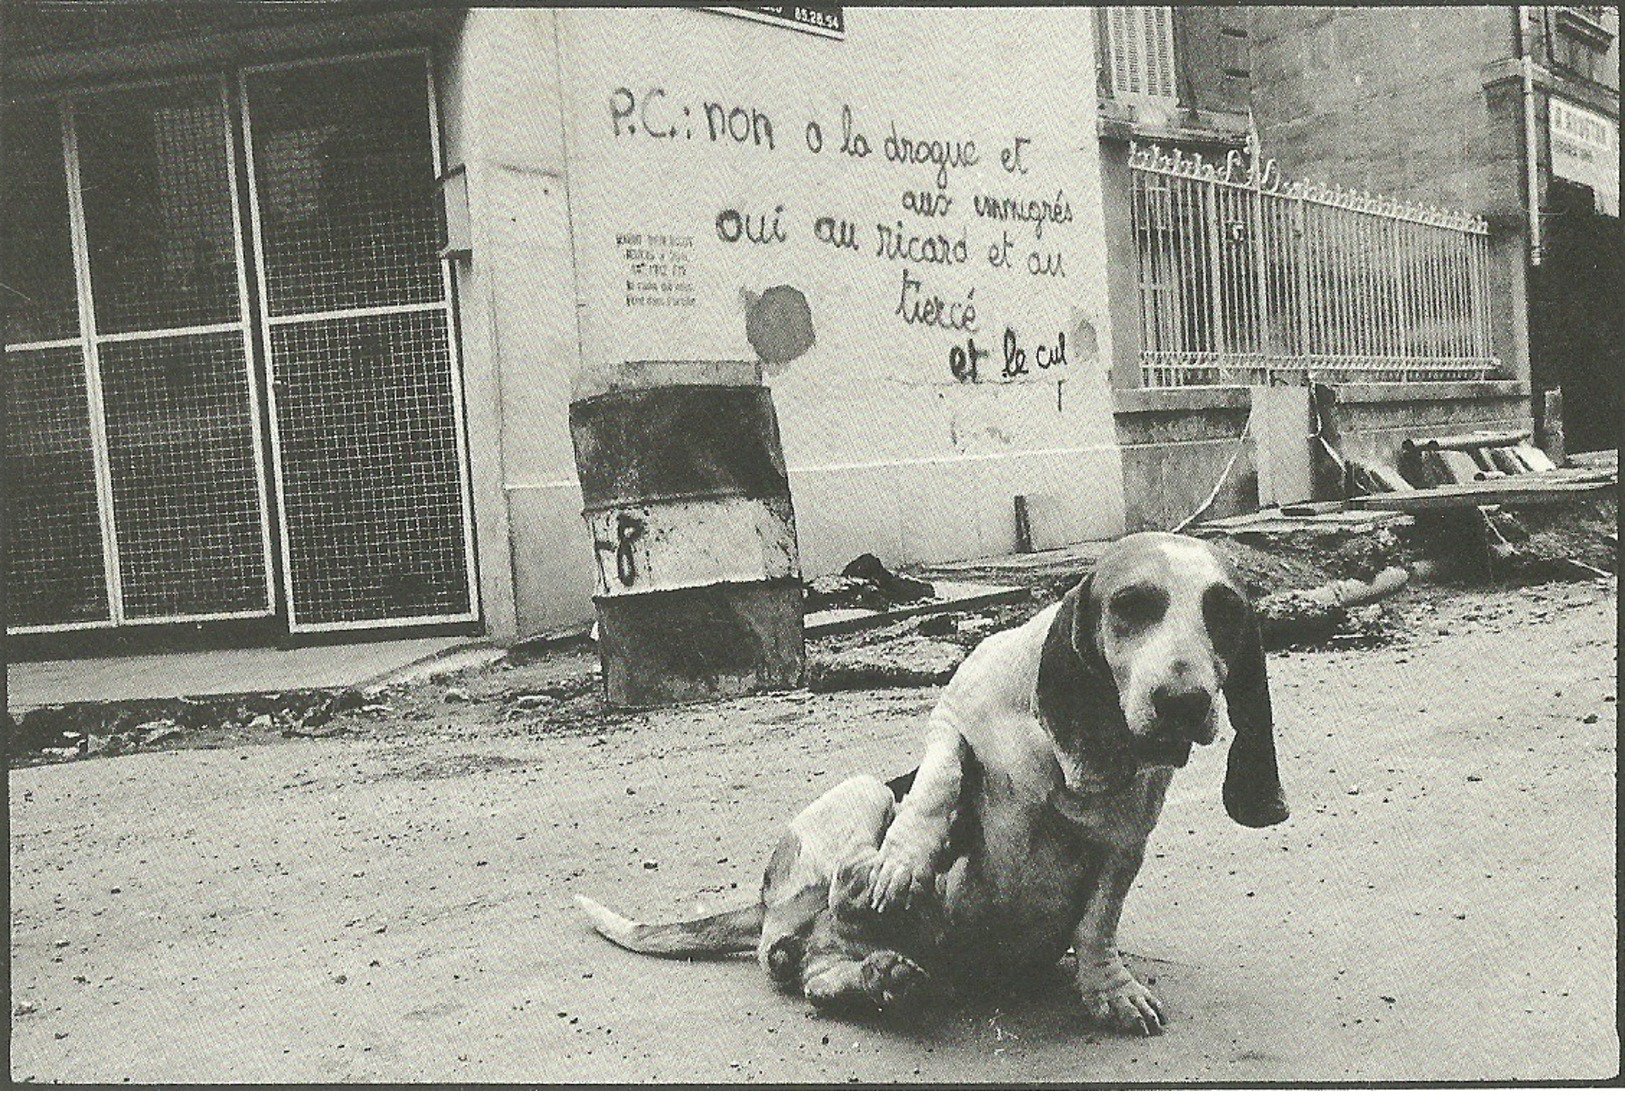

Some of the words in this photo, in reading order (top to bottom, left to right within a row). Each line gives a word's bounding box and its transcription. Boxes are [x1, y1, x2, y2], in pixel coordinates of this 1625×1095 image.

[703, 101, 776, 151] non
[884, 120, 979, 190] drogue
[1000, 136, 1031, 175] et
[715, 204, 787, 245] oui
[813, 216, 860, 251] au
[988, 231, 1015, 268] et
[1027, 252, 1066, 278] au
[949, 338, 989, 384] et
[1001, 326, 1029, 378] le
